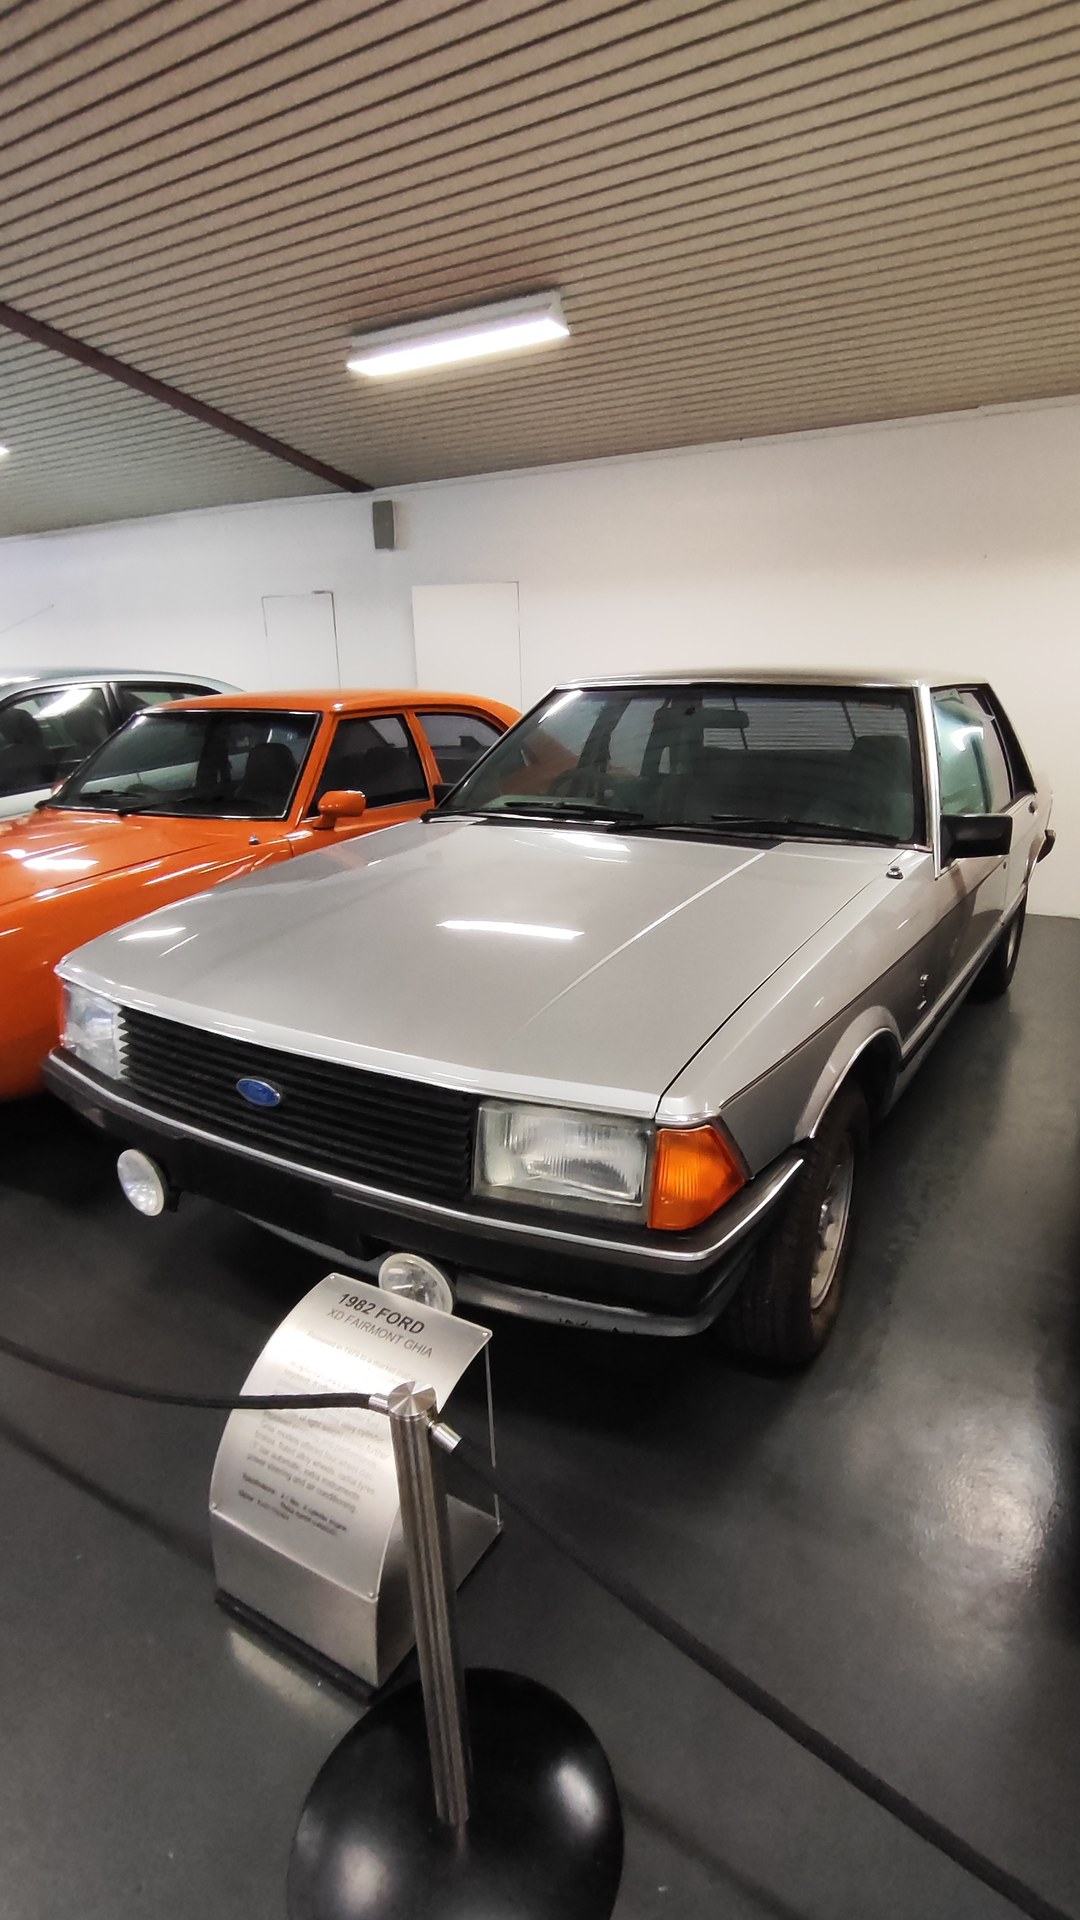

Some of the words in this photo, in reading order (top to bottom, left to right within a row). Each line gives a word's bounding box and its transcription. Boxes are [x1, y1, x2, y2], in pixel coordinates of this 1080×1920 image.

[327, 1308, 345, 1321] XD
[344, 1317, 404, 1345] FAIRMONT
[403, 1339, 433, 1358] GHIA
[338, 1293, 376, 1315] 1982
[374, 1307, 425, 1334] FORD
